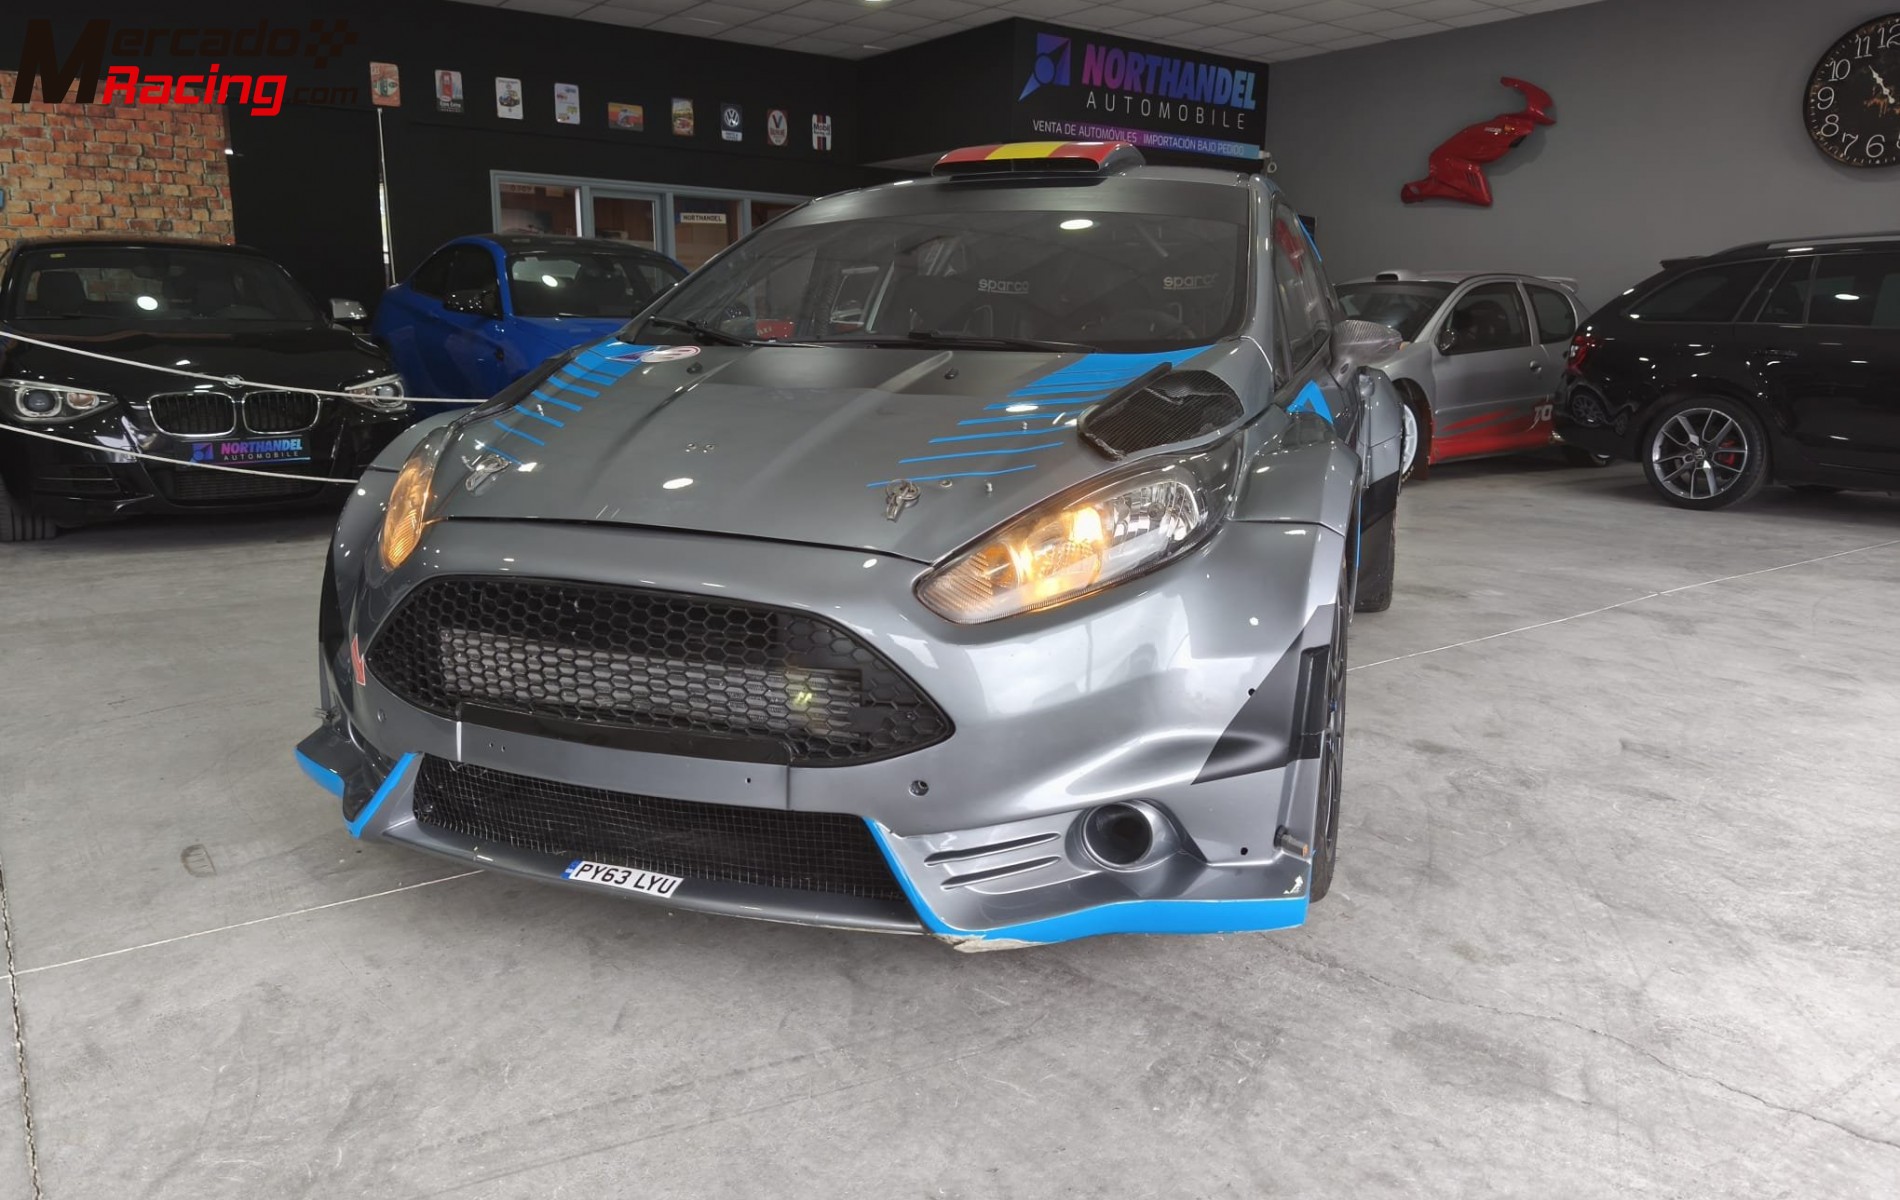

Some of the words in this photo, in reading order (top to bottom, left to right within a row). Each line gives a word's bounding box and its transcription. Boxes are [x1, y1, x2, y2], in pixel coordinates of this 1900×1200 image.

[1854, 34, 1872, 59] 11
[1082, 43, 1256, 110] NORTHANDEL
[1825, 58, 1850, 82] 10
[1817, 86, 1835, 110] 9
[1086, 91, 1246, 130] AUTOMOBILE
[1820, 114, 1839, 137] 8
[1032, 119, 1063, 135] VENTA
[1064, 123, 1077, 136] DE
[1078, 125, 1138, 144] AUTOMÓVILES
[1143, 134, 1196, 151] IMPORTACIÓN
[1198, 140, 1217, 154] BAJO
[1217, 142, 1245, 157] PEDIDO
[1841, 132, 1859, 156] 7
[1866, 134, 1885, 158] 6
[682, 214, 723, 222] NORTHANDEL
[978, 278, 1029, 294] sparco
[221, 439, 302, 455] NORTHANDEL
[223, 451, 299, 461] AUTOMOBILE
[574, 863, 632, 885] PY63
[633, 873, 676, 894] LYU
